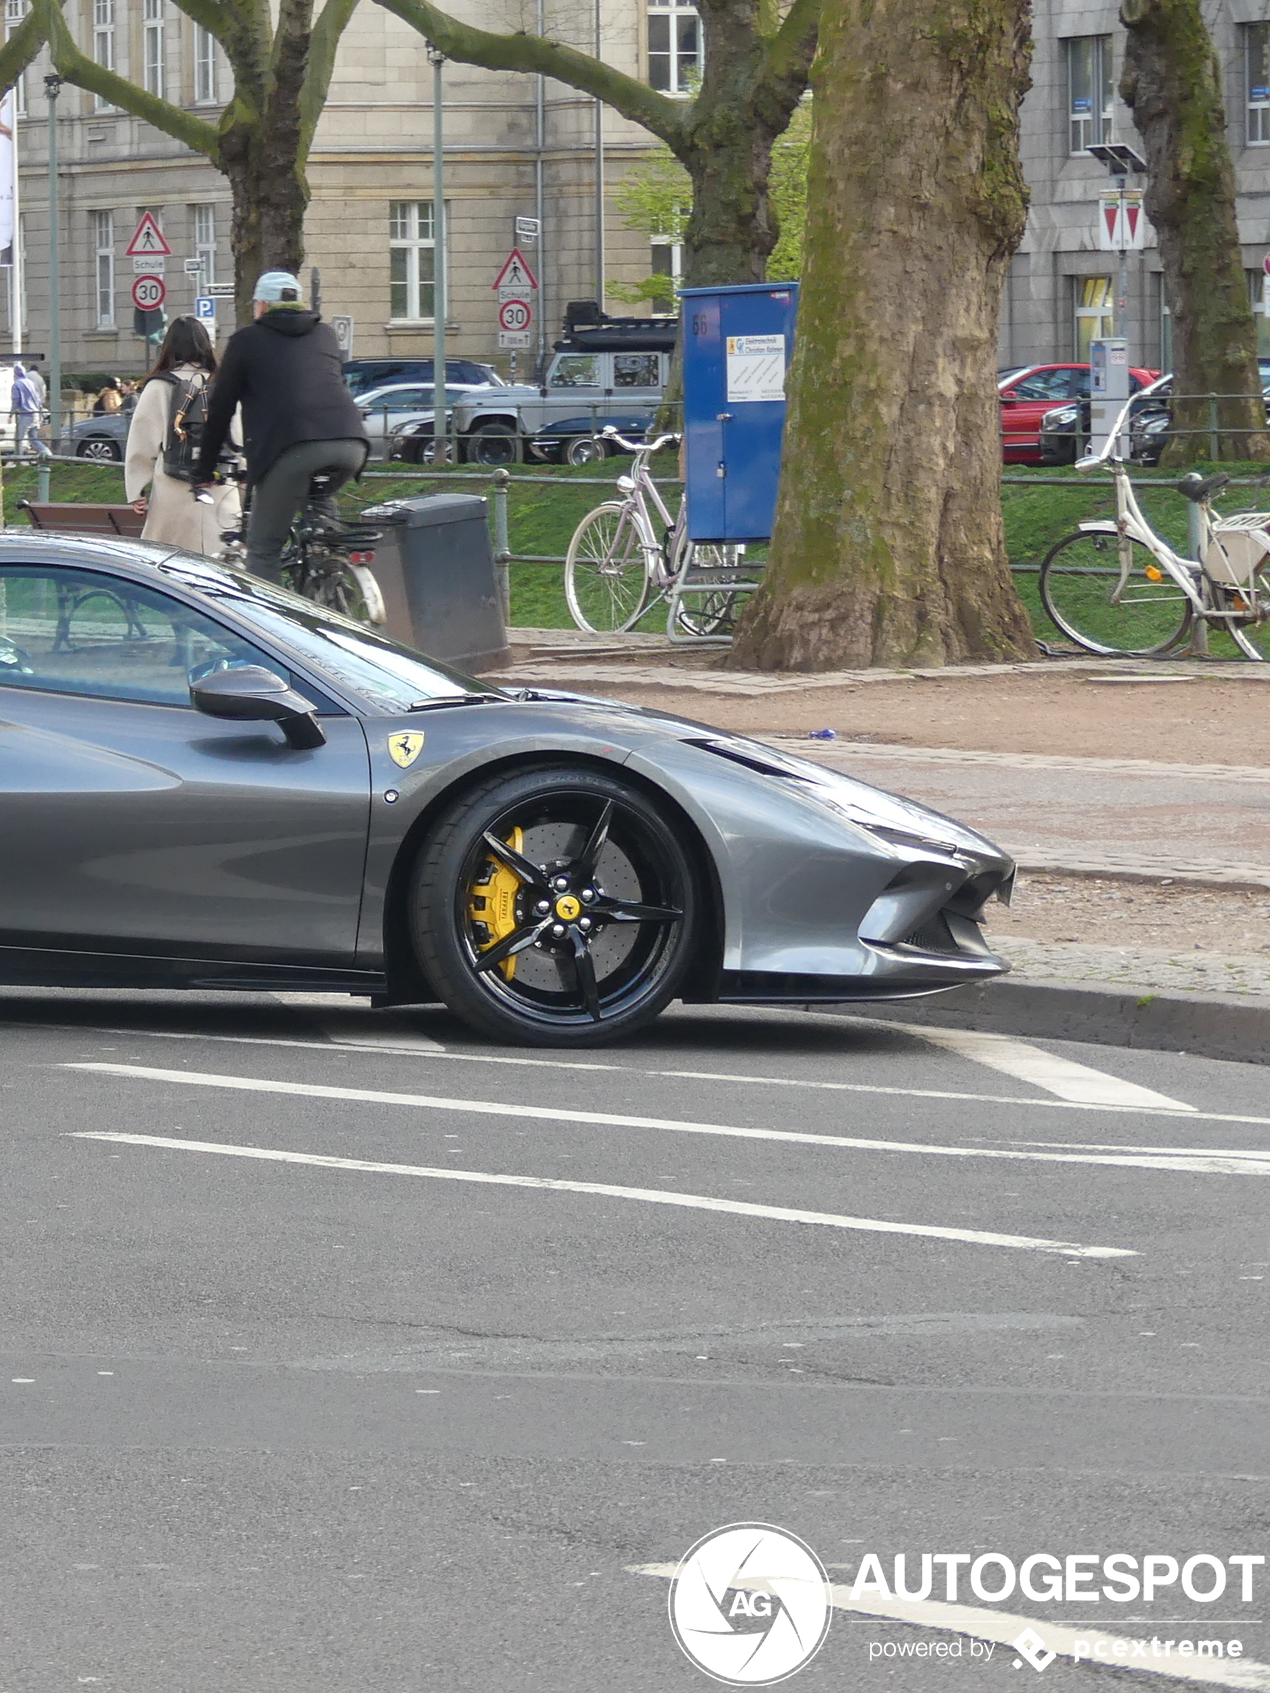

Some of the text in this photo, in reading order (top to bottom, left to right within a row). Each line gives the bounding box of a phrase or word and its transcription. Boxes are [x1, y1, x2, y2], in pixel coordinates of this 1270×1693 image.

[134, 260, 164, 269] Schule
[138, 285, 159, 300] 30
[500, 291, 530, 299] Schule
[199, 301, 211, 317] P
[505, 309, 525, 324] 30
